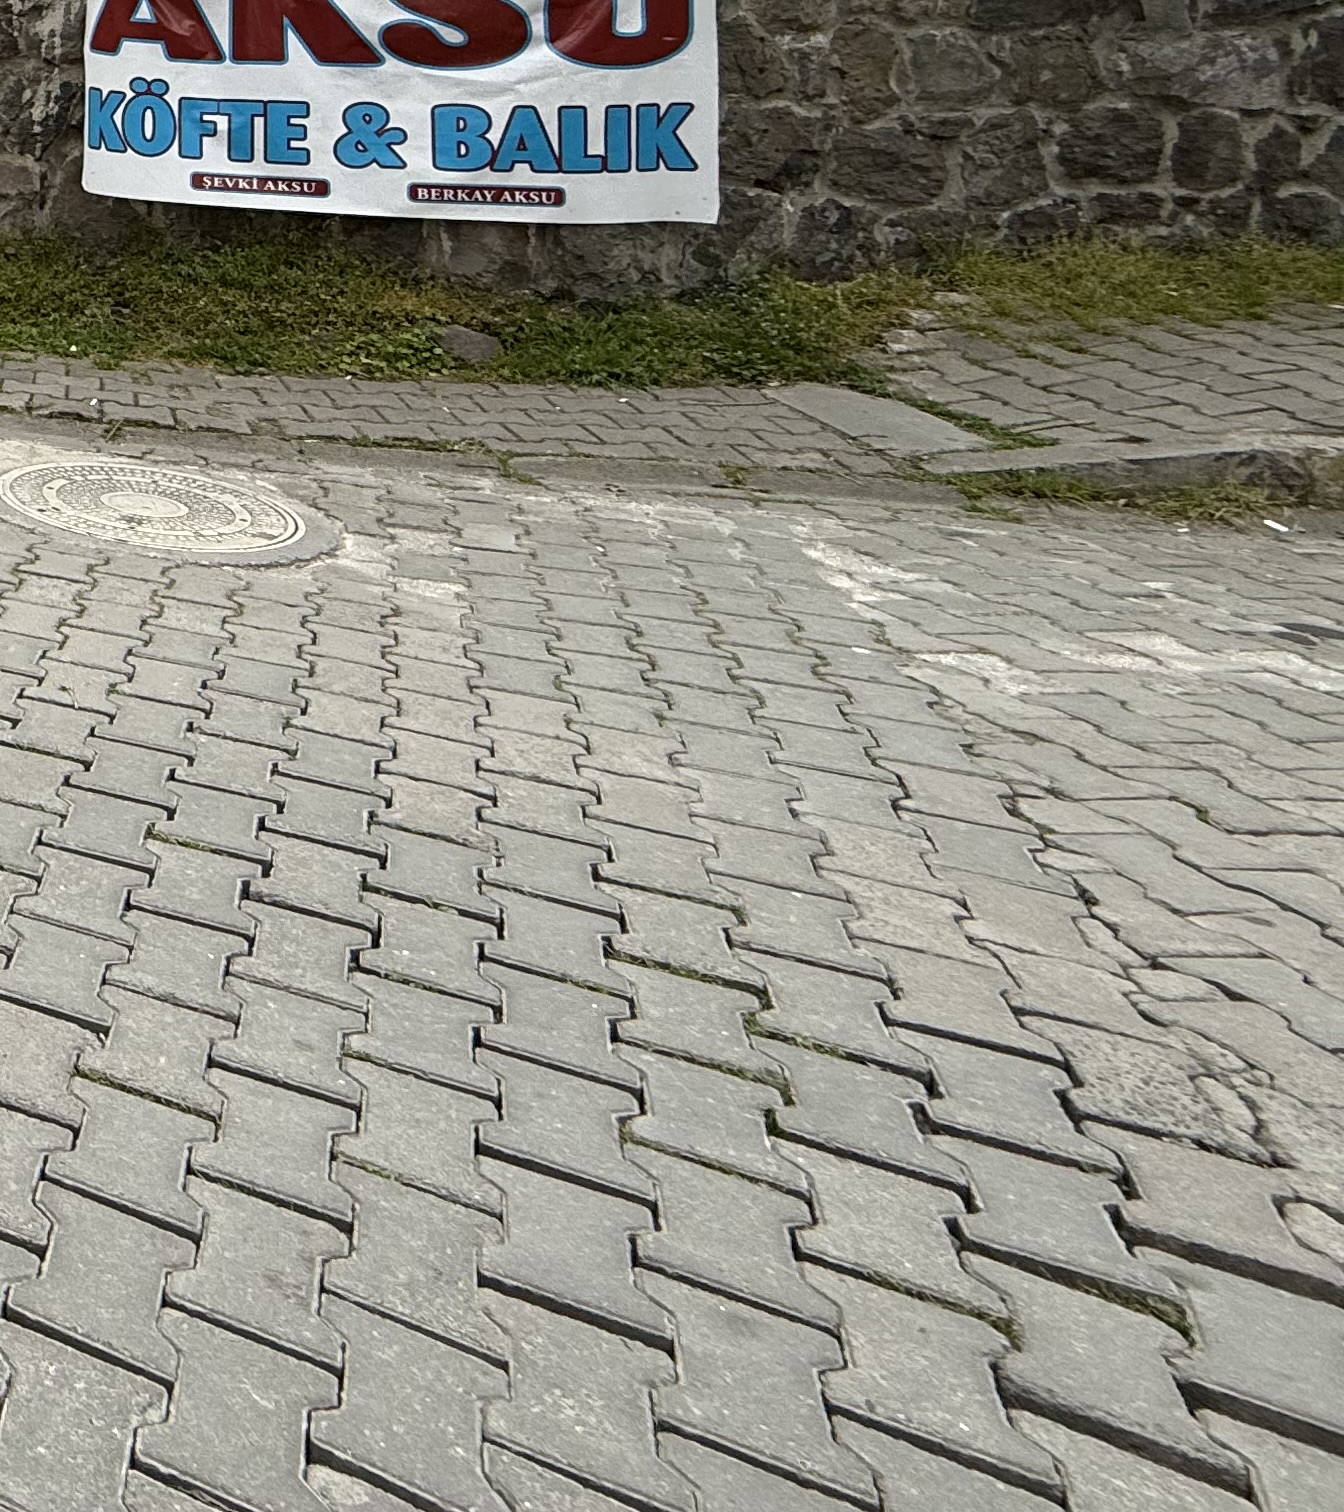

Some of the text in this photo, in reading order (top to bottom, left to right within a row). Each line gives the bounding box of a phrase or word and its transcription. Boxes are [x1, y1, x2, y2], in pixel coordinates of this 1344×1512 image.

[88, 77, 699, 174] KÖFTE & BALIK
[202, 175, 317, 193] ŞEVKİ AKSU
[416, 188, 556, 205] BERKAY AKSU
